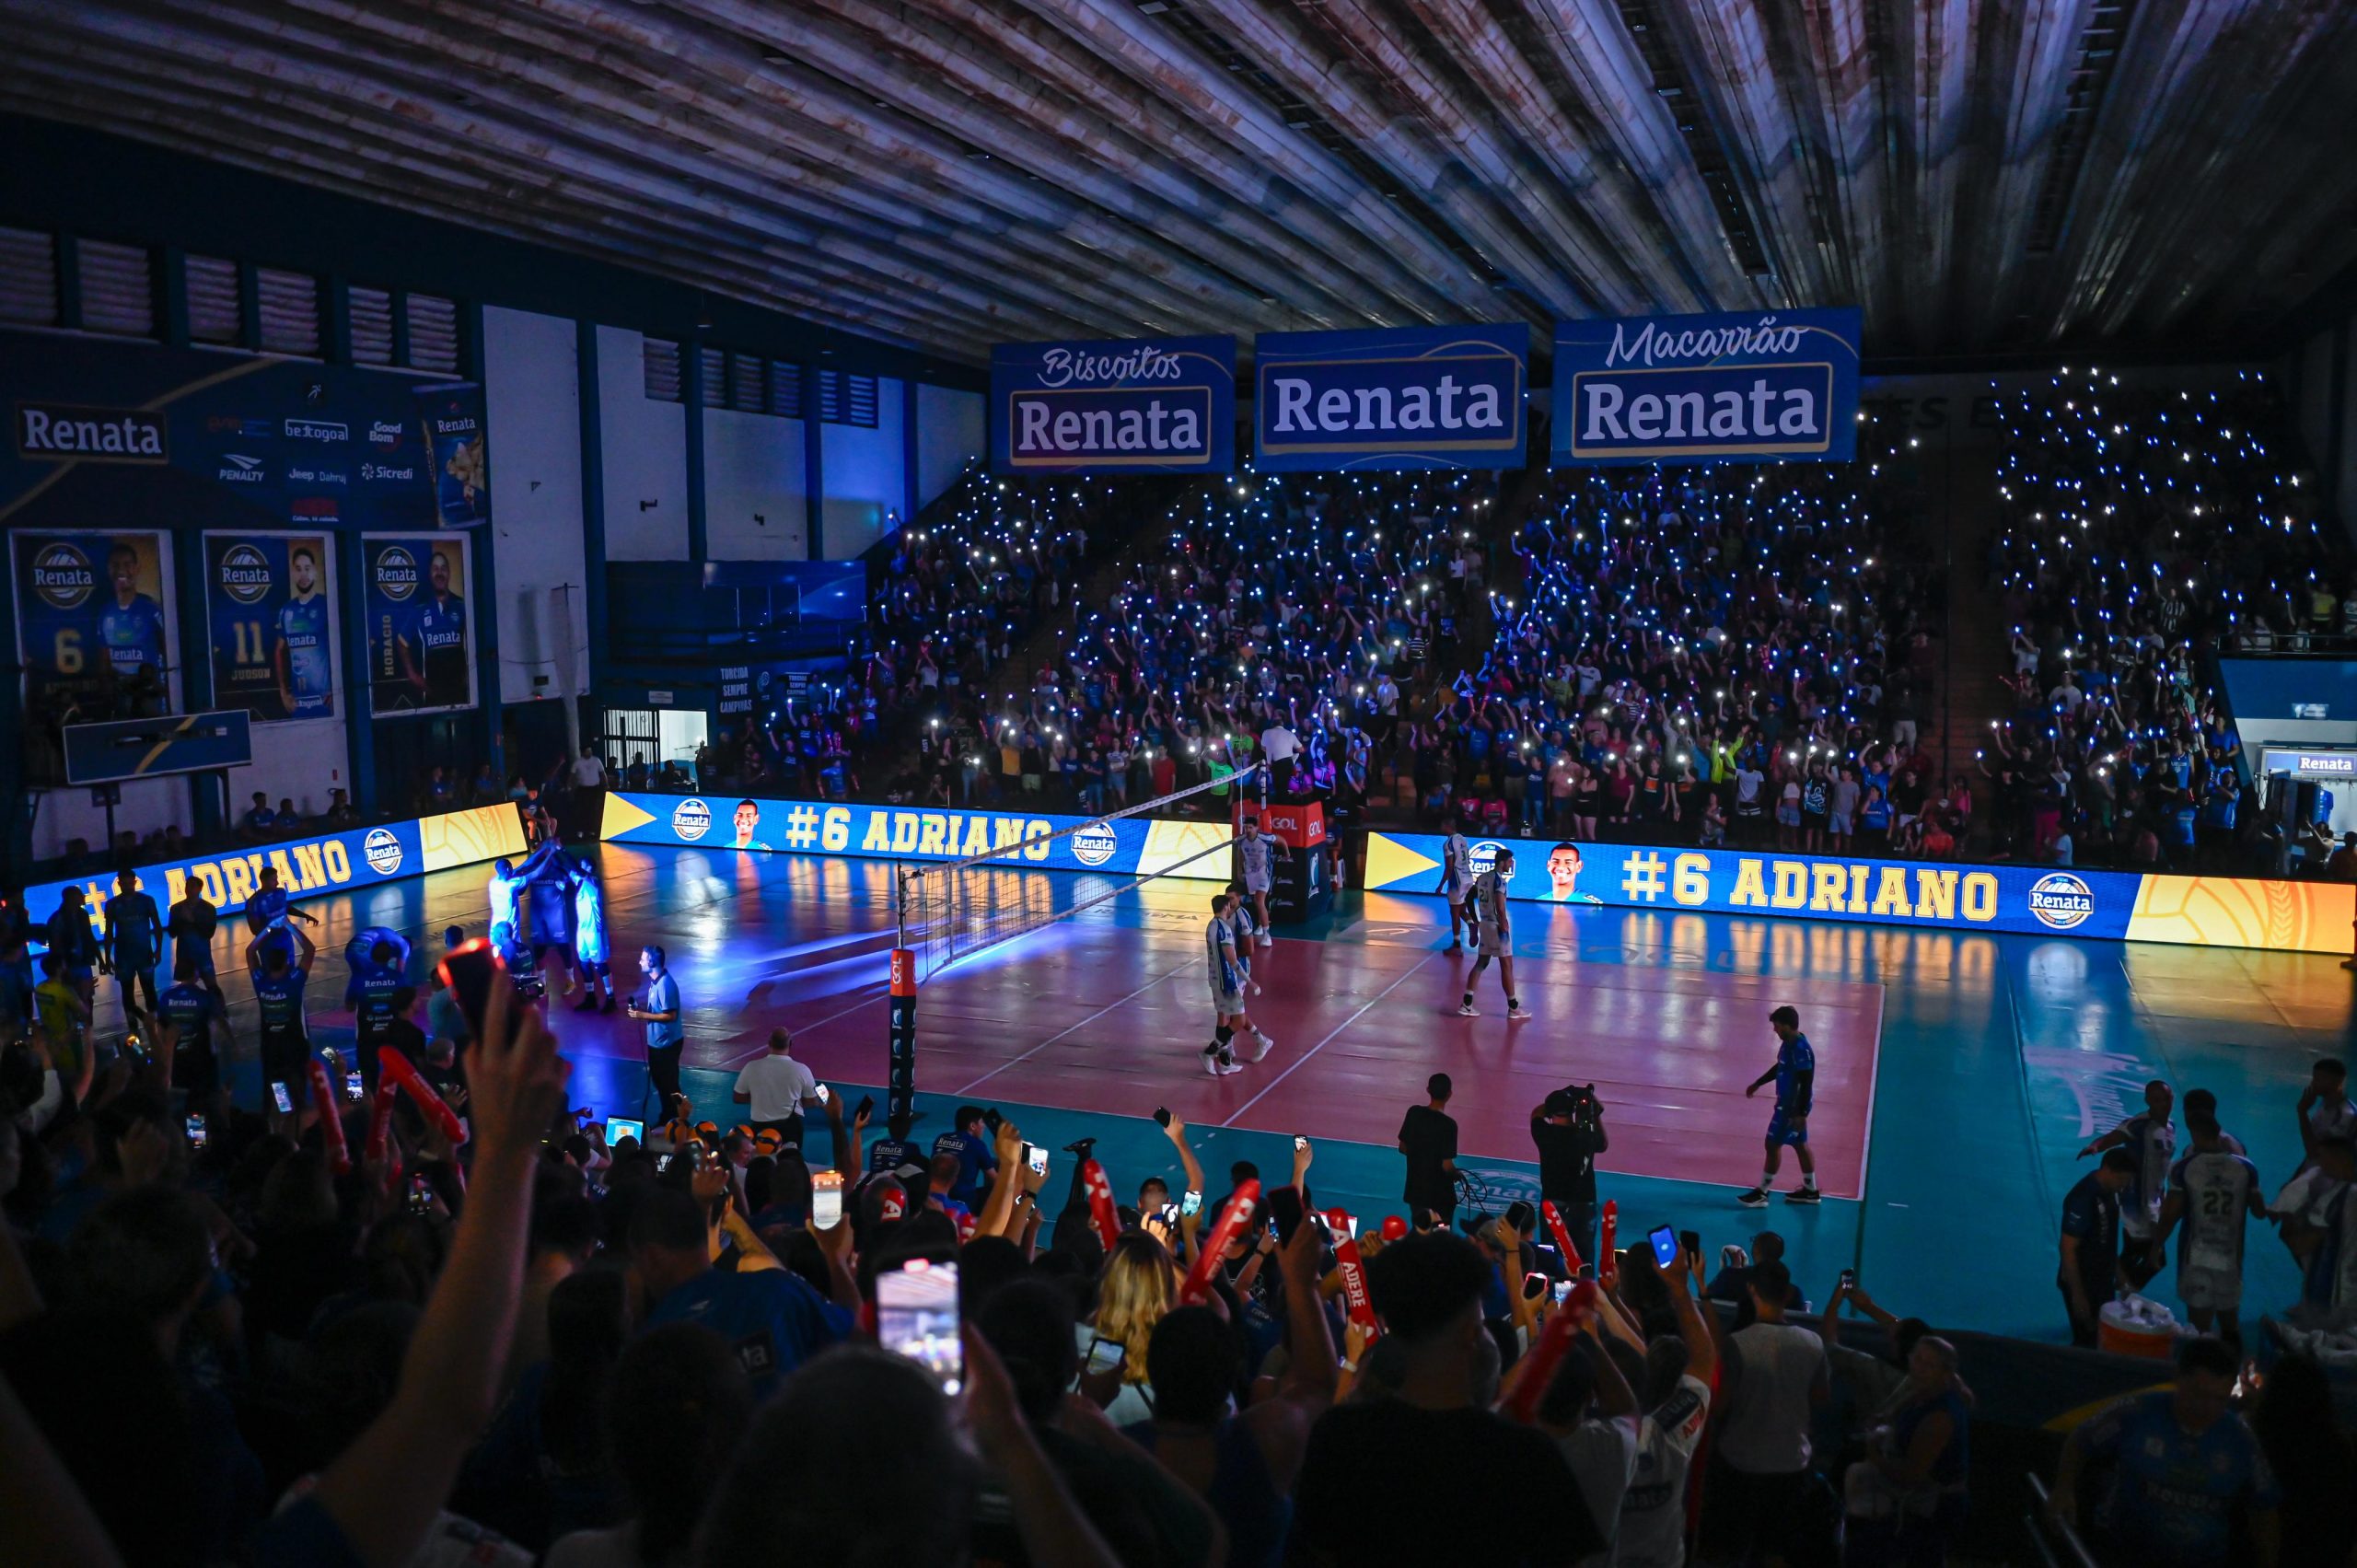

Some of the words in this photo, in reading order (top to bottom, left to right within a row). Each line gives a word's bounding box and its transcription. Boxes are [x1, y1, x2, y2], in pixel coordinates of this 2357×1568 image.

[1605, 316, 1809, 368] Macarrão
[1037, 346, 1182, 388] Biscoitos
[1273, 375, 1504, 434] Renata
[1583, 378, 1818, 442] Renata
[22, 410, 162, 456] Renata
[373, 420, 402, 434] Good
[437, 417, 476, 434] Renata
[1018, 401, 1202, 454] Renata
[368, 430, 395, 443] Bom
[219, 469, 265, 482] PENALTY
[288, 468, 315, 482] Jeep
[376, 466, 412, 480] Sicredi
[34, 568, 94, 587] Renata
[221, 567, 271, 584] Renata
[377, 567, 418, 584] Renata
[232, 621, 266, 665] 11
[382, 614, 395, 676] HORACIO
[426, 631, 462, 647] Renata
[54, 628, 85, 675] 6
[231, 667, 271, 680] JUDSON
[2300, 757, 2352, 771] Renata
[673, 813, 710, 827] Renata
[1271, 817, 1298, 830] GOL
[1308, 819, 1322, 837] GOL
[787, 807, 851, 851] #6
[863, 812, 1051, 861] ADRIANO
[1073, 836, 1114, 851] Renata
[366, 844, 401, 861] Renata
[1622, 852, 1710, 905] #6
[1730, 859, 1998, 922] ADRIANO
[2031, 892, 2091, 911] Renata
[892, 957, 903, 984] GOL
[365, 980, 396, 988] Renata
[168, 998, 197, 1007] Renata
[876, 1144, 903, 1155] Renata
[937, 1136, 965, 1149] Renata
[1341, 1261, 1366, 1307] ADERE
